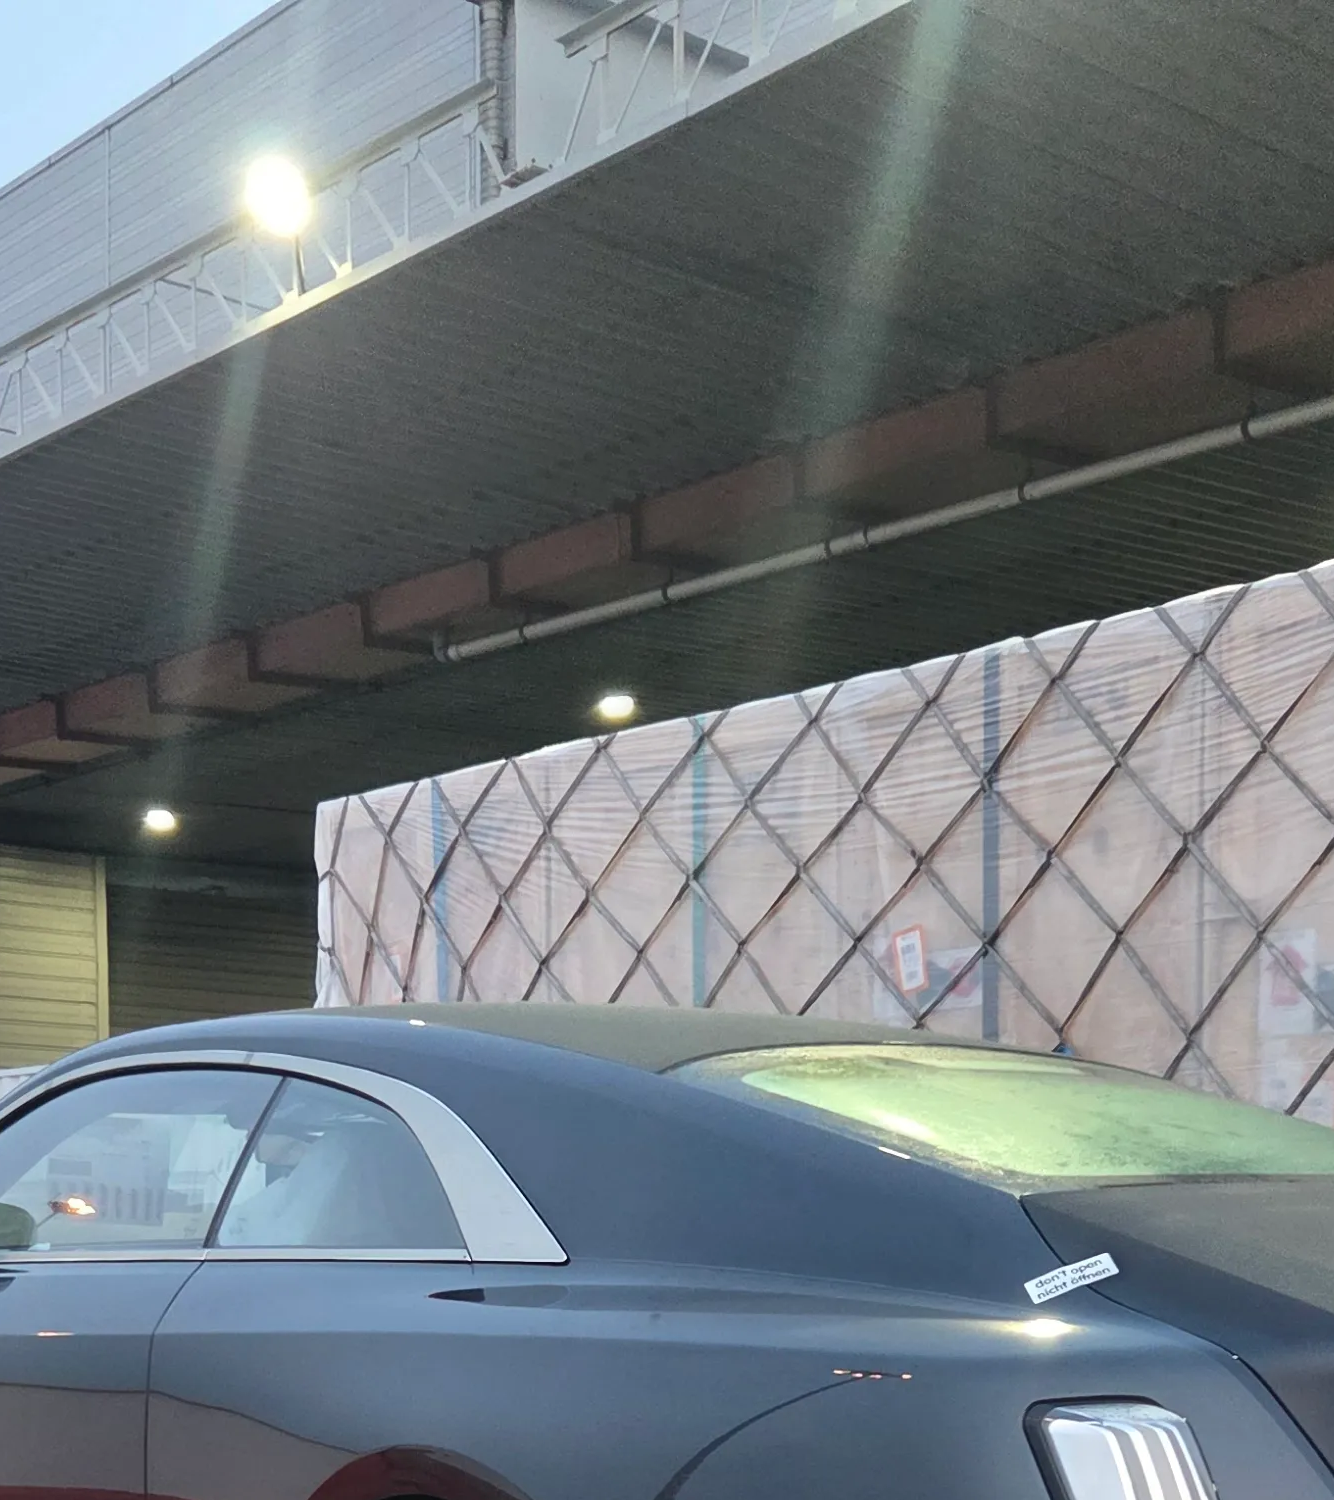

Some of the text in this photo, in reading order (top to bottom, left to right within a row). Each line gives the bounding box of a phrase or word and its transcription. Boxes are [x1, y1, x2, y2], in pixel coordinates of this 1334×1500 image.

[1035, 1258, 1102, 1289] don't open
[1037, 1266, 1111, 1300] nicht öffnen
